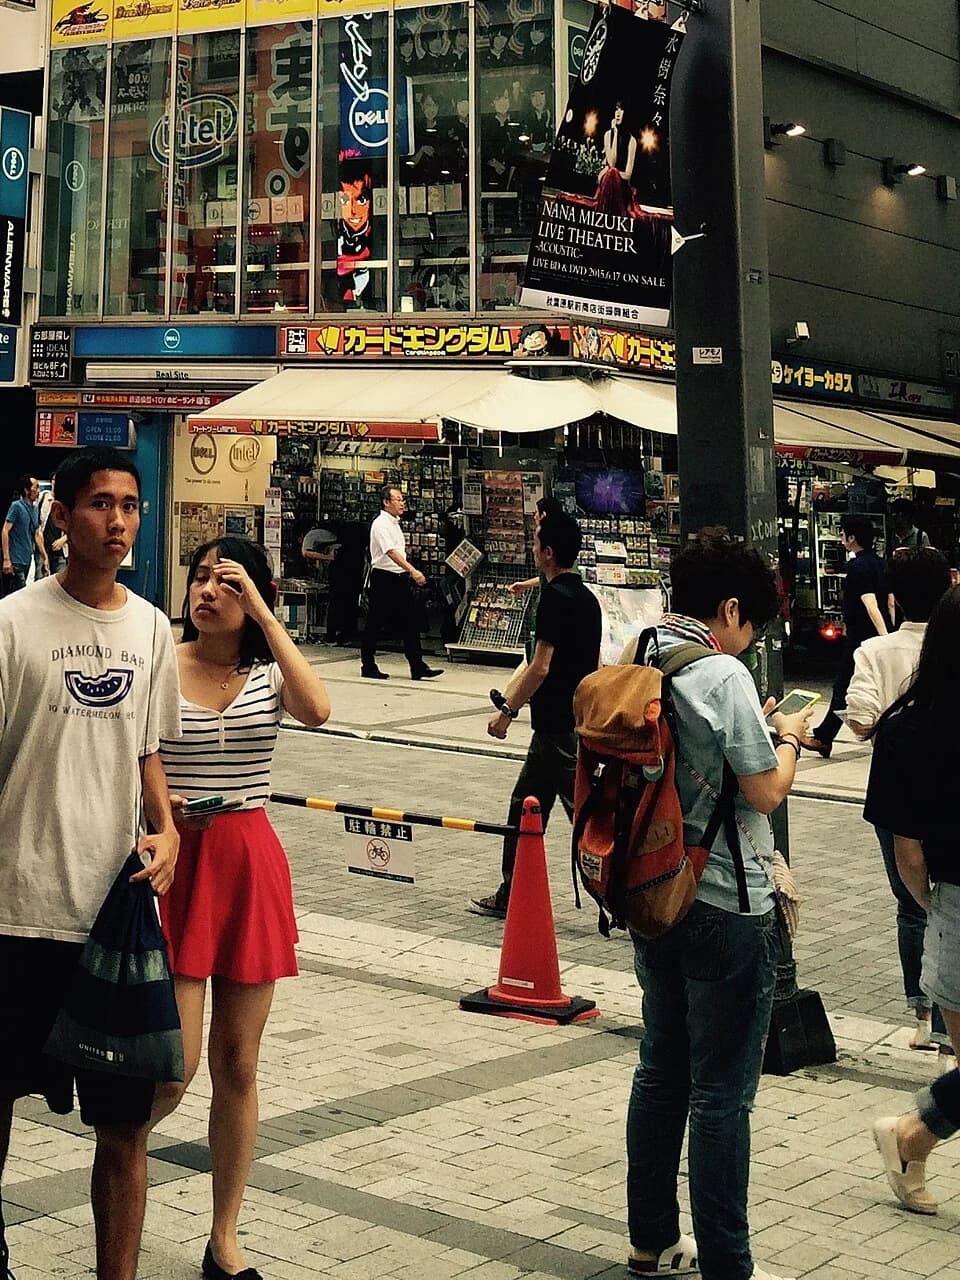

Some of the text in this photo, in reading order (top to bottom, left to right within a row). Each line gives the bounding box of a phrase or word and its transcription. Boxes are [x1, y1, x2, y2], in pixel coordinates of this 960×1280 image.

[541, 198, 636, 235] NANA MIZUKI
[537, 220, 639, 256] LIVE THEATER
[3, 220, 15, 308] ALIENWARE
[532, 257, 549, 271] LIVE
[569, 264, 588, 277] DVD
[622, 271, 639, 285] ON
[640, 273, 666, 288] SALE
[344, 325, 512, 353] カードキングダム
[267, 420, 351, 436] カードキングダム
[51, 644, 146, 668] DIAMOND BAR
[62, 705, 121, 720] WATERMELON
[348, 818, 409, 840] 駐輪禁止
